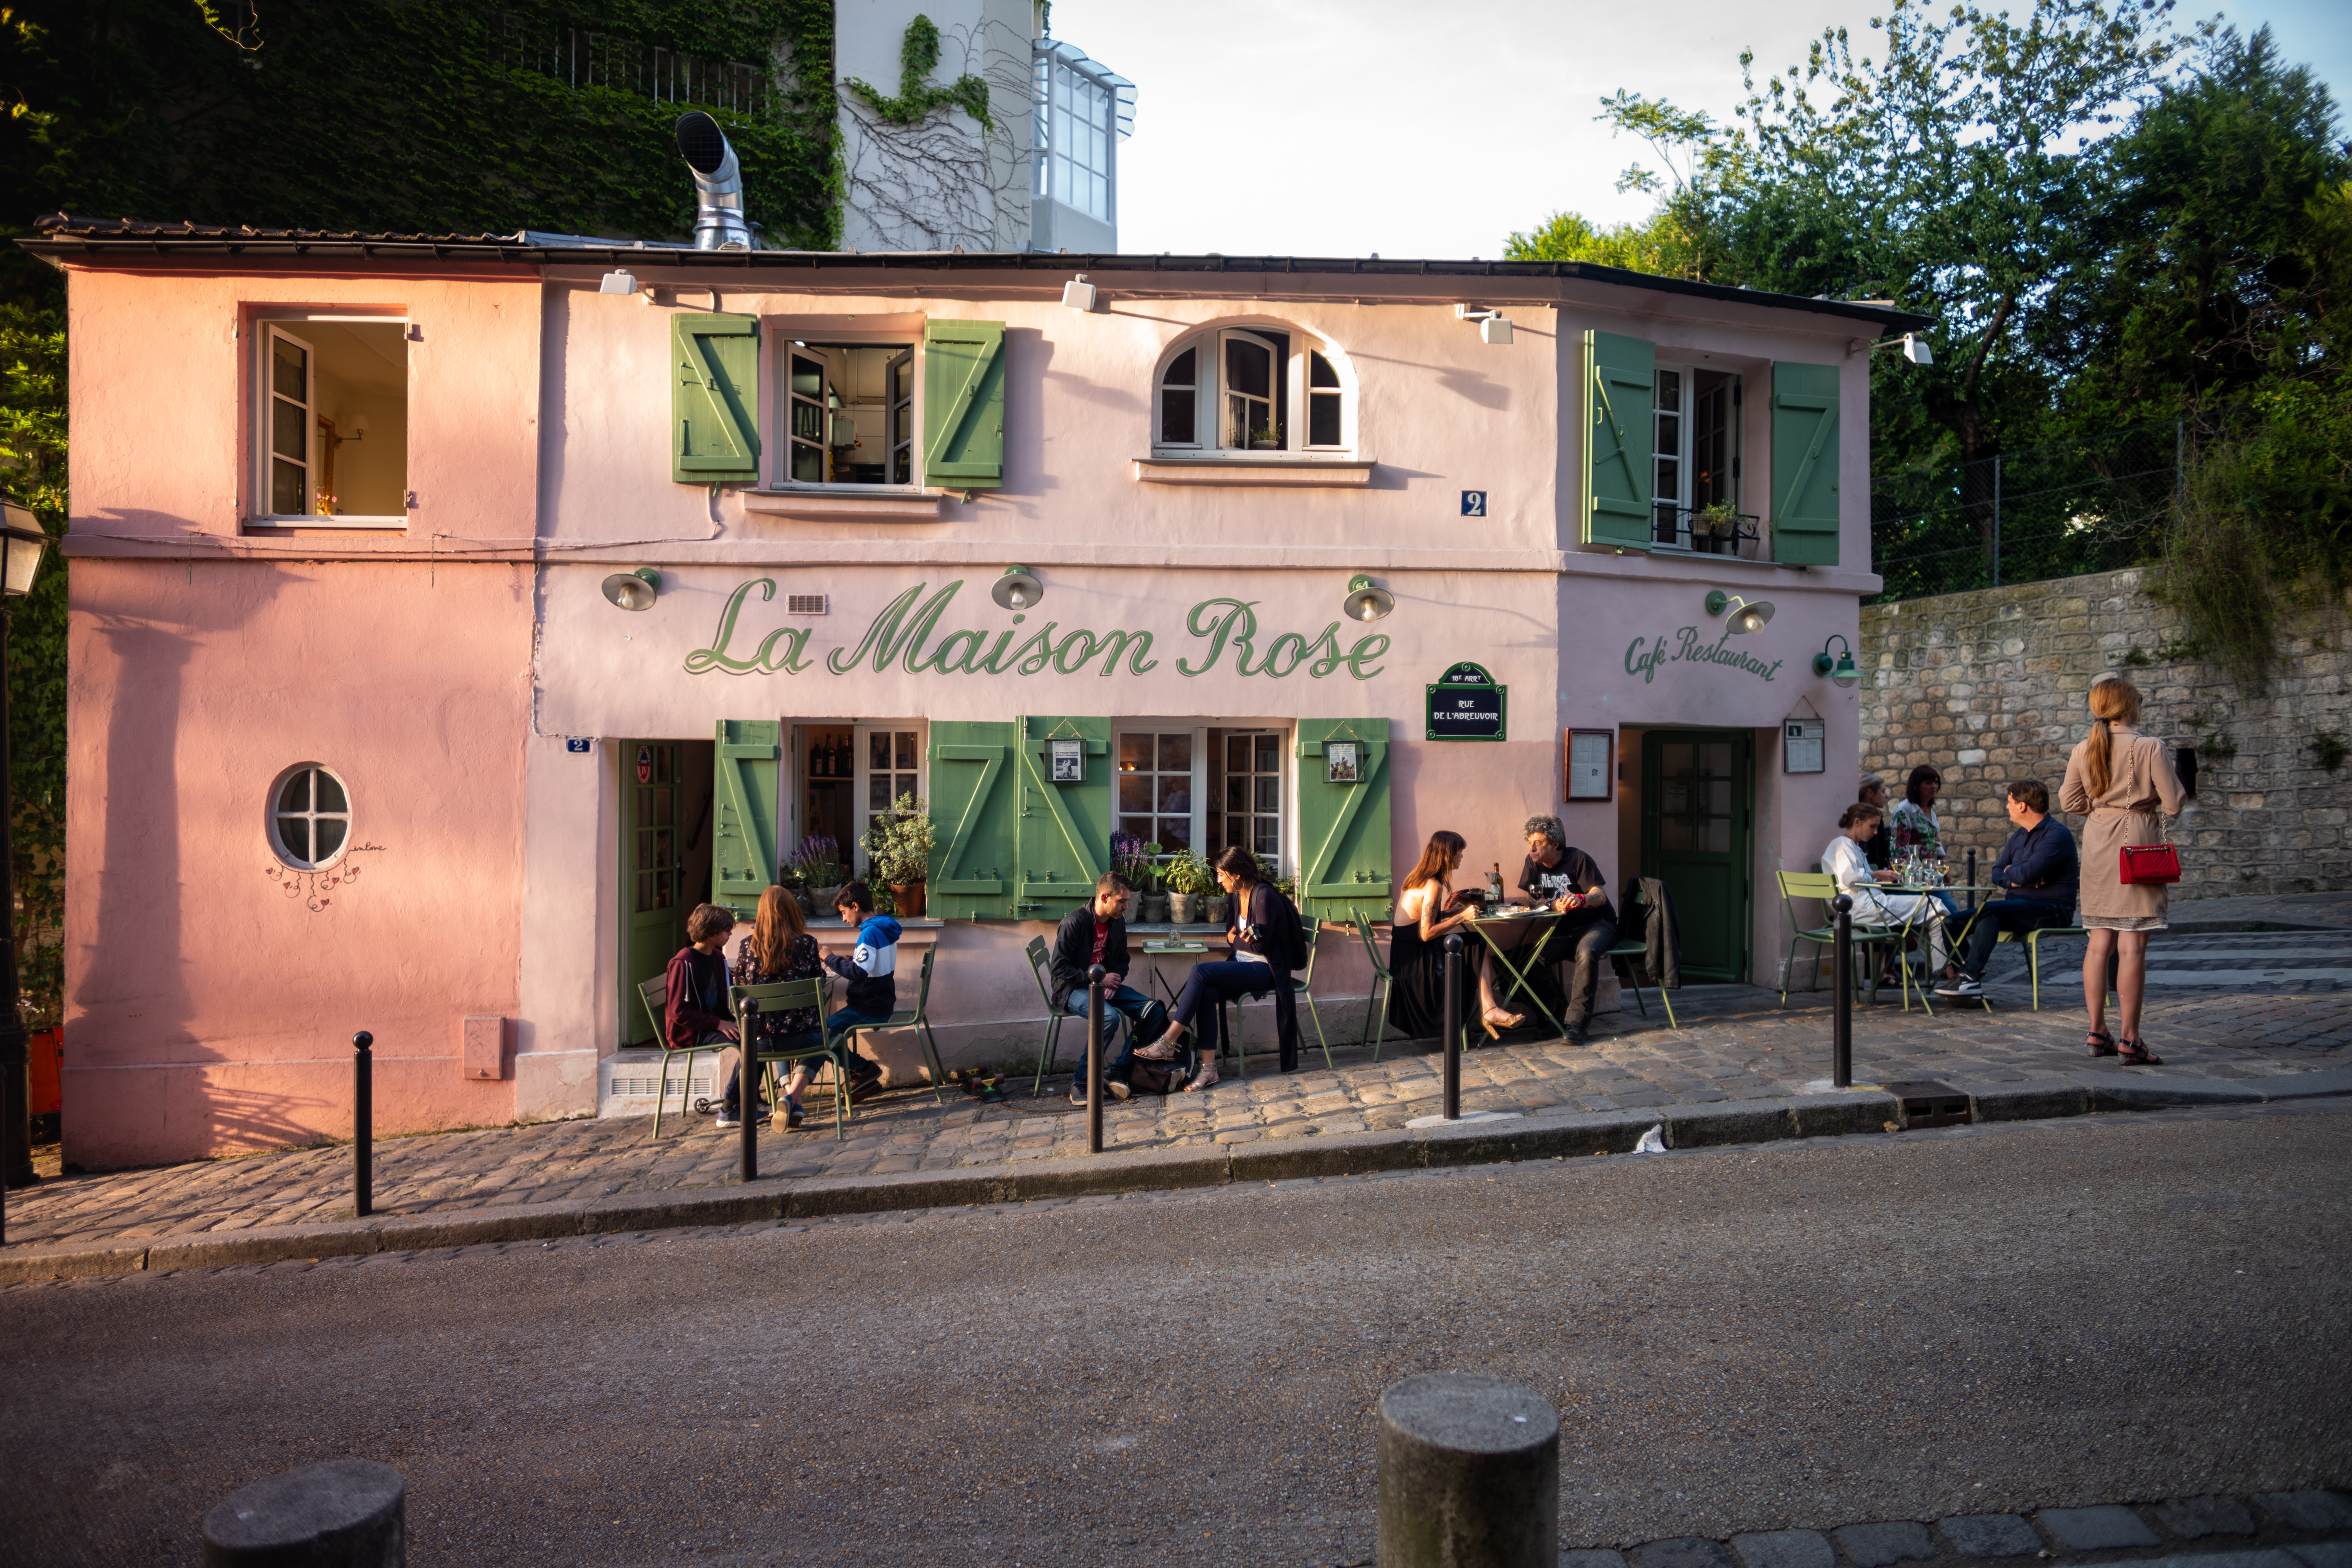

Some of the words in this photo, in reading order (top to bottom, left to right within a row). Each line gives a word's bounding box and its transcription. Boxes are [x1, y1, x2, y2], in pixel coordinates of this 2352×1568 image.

[1468, 492, 1481, 515] 2
[683, 578, 814, 676] La
[827, 579, 1158, 676] Maison
[1176, 597, 1391, 680] Rose
[1625, 636, 1667, 684] Café
[1671, 626, 1783, 681] Restaurant
[1459, 700, 1475, 708] RUE
[1447, 712, 1498, 721] L'ABREUVOIR
[574, 739, 583, 751] 2
[642, 766, 647, 774] IV
